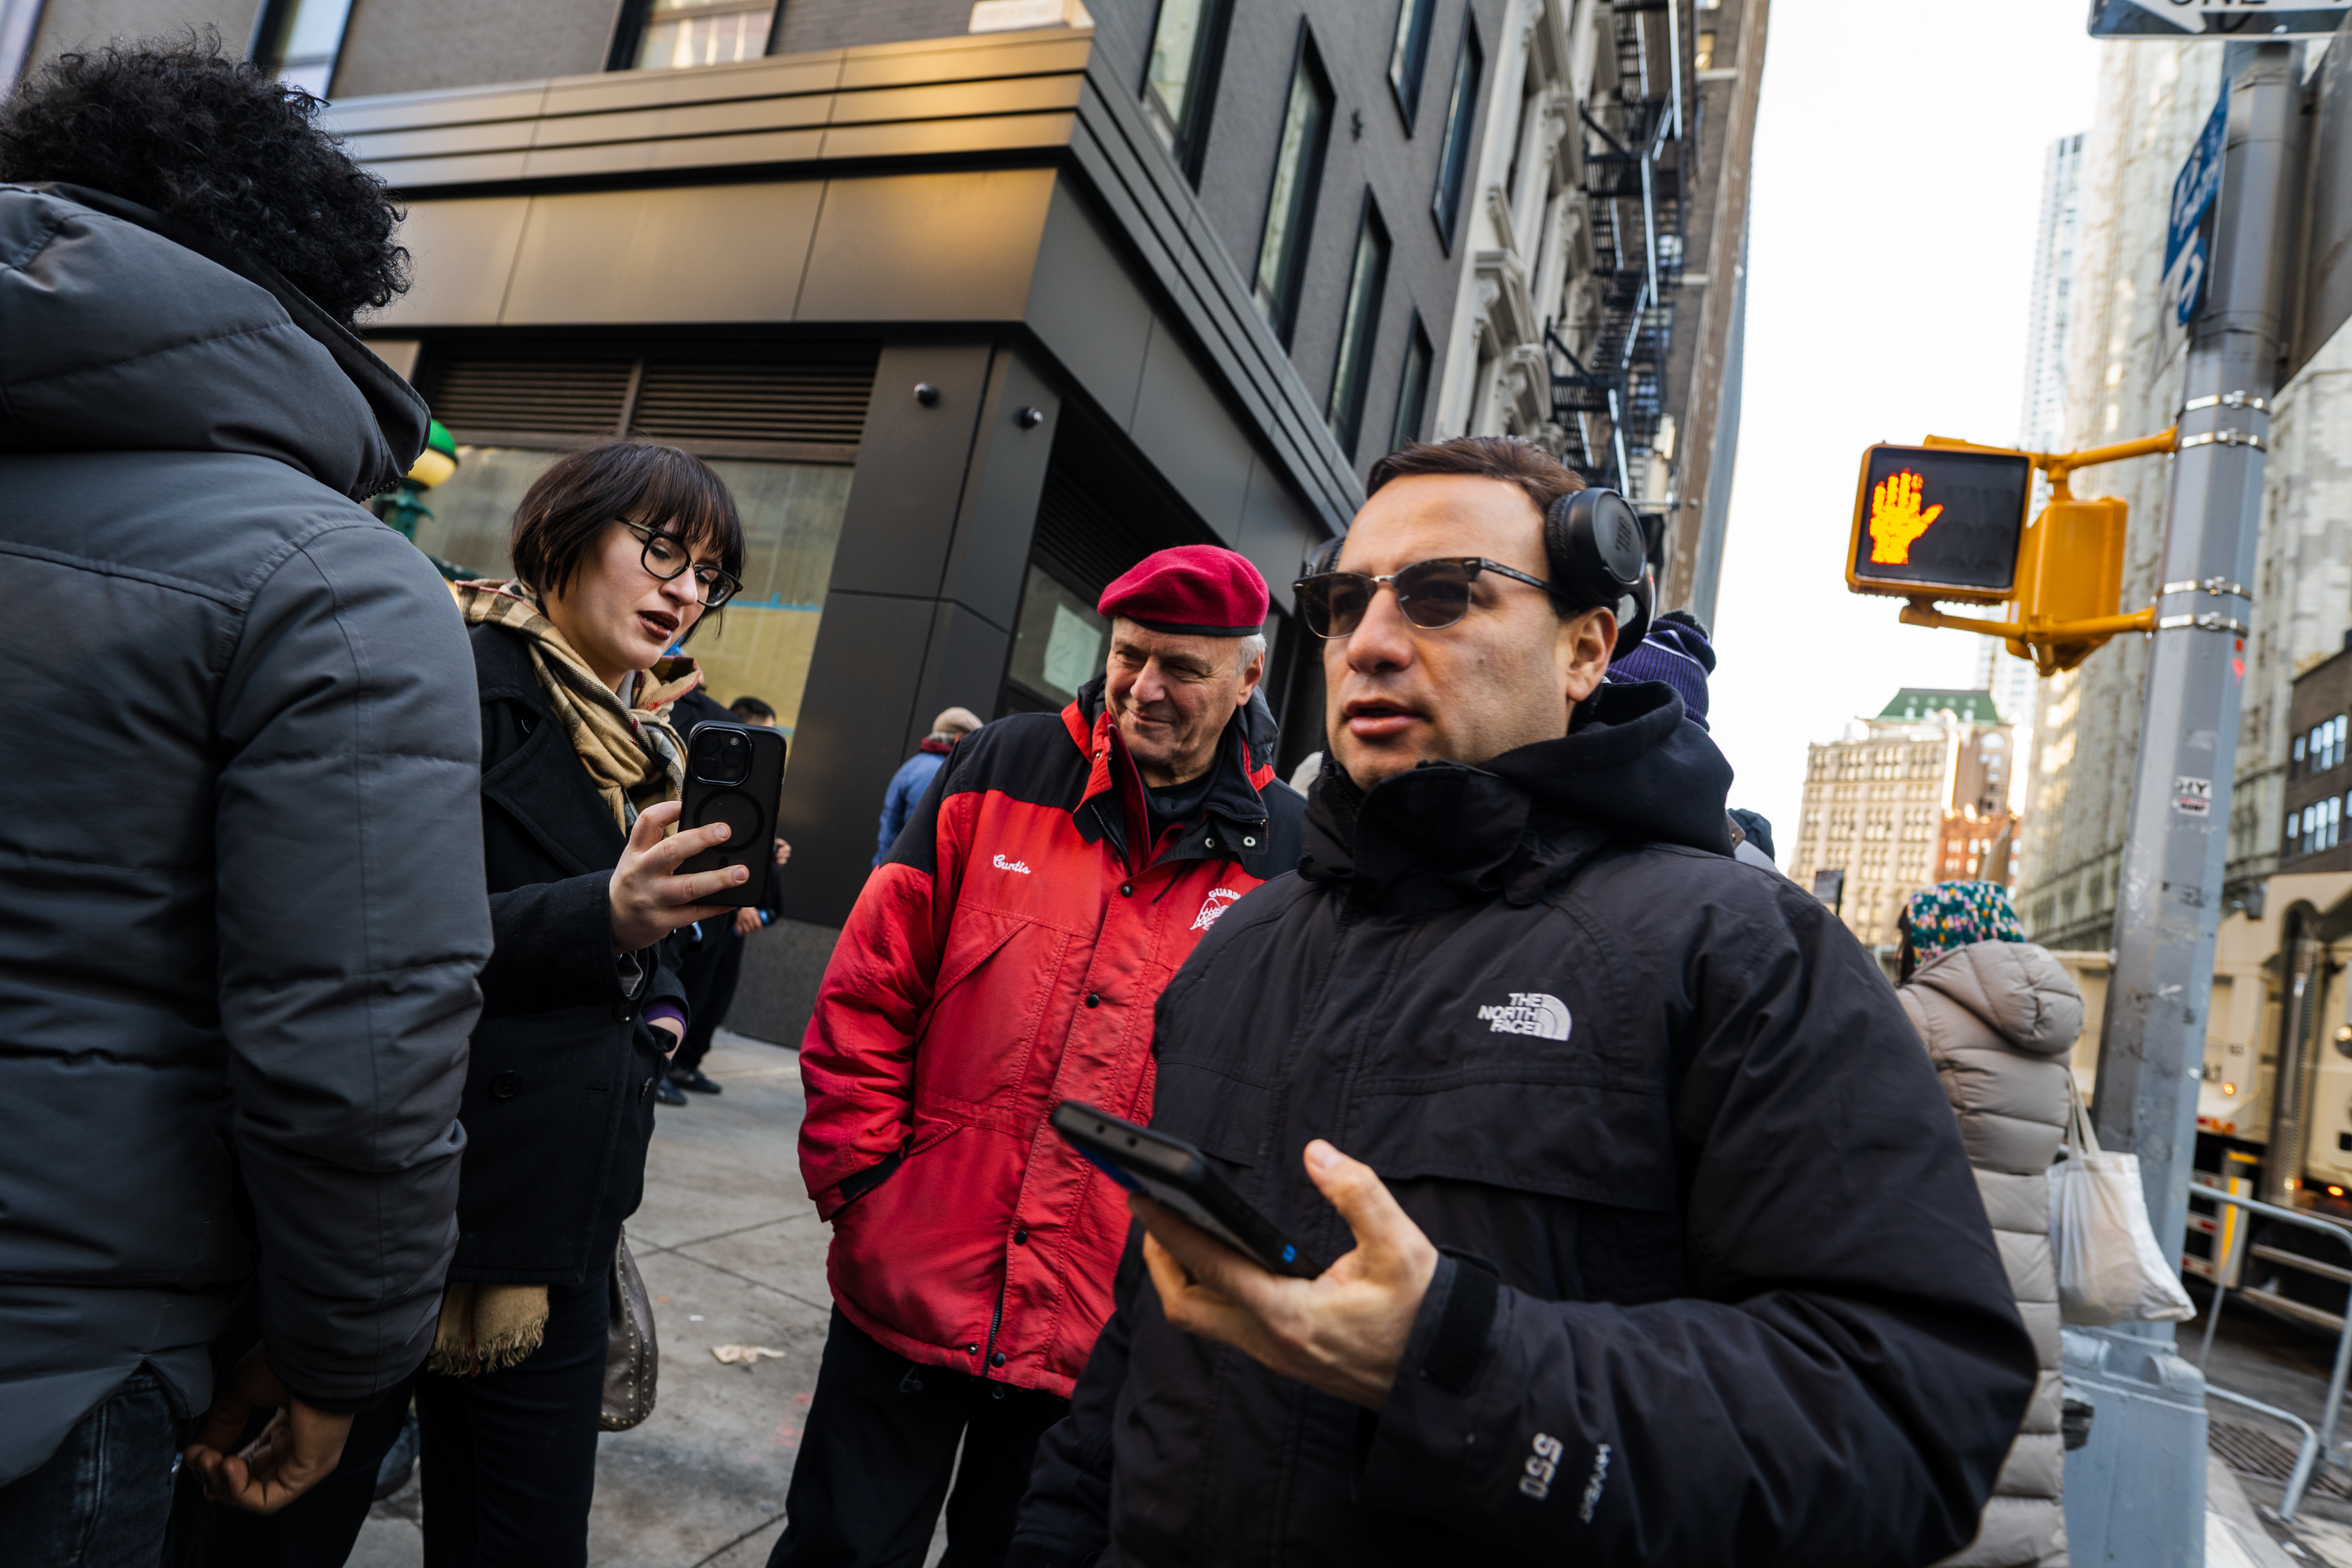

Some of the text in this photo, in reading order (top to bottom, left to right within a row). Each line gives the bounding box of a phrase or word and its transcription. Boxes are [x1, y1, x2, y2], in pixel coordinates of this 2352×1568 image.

[993, 854, 1032, 875] Curtis
[1508, 992, 1542, 1008] THE
[1477, 1005, 1537, 1021] NORTH
[1490, 1019, 1535, 1035] FACE
[1518, 1432, 1564, 1502] 550
